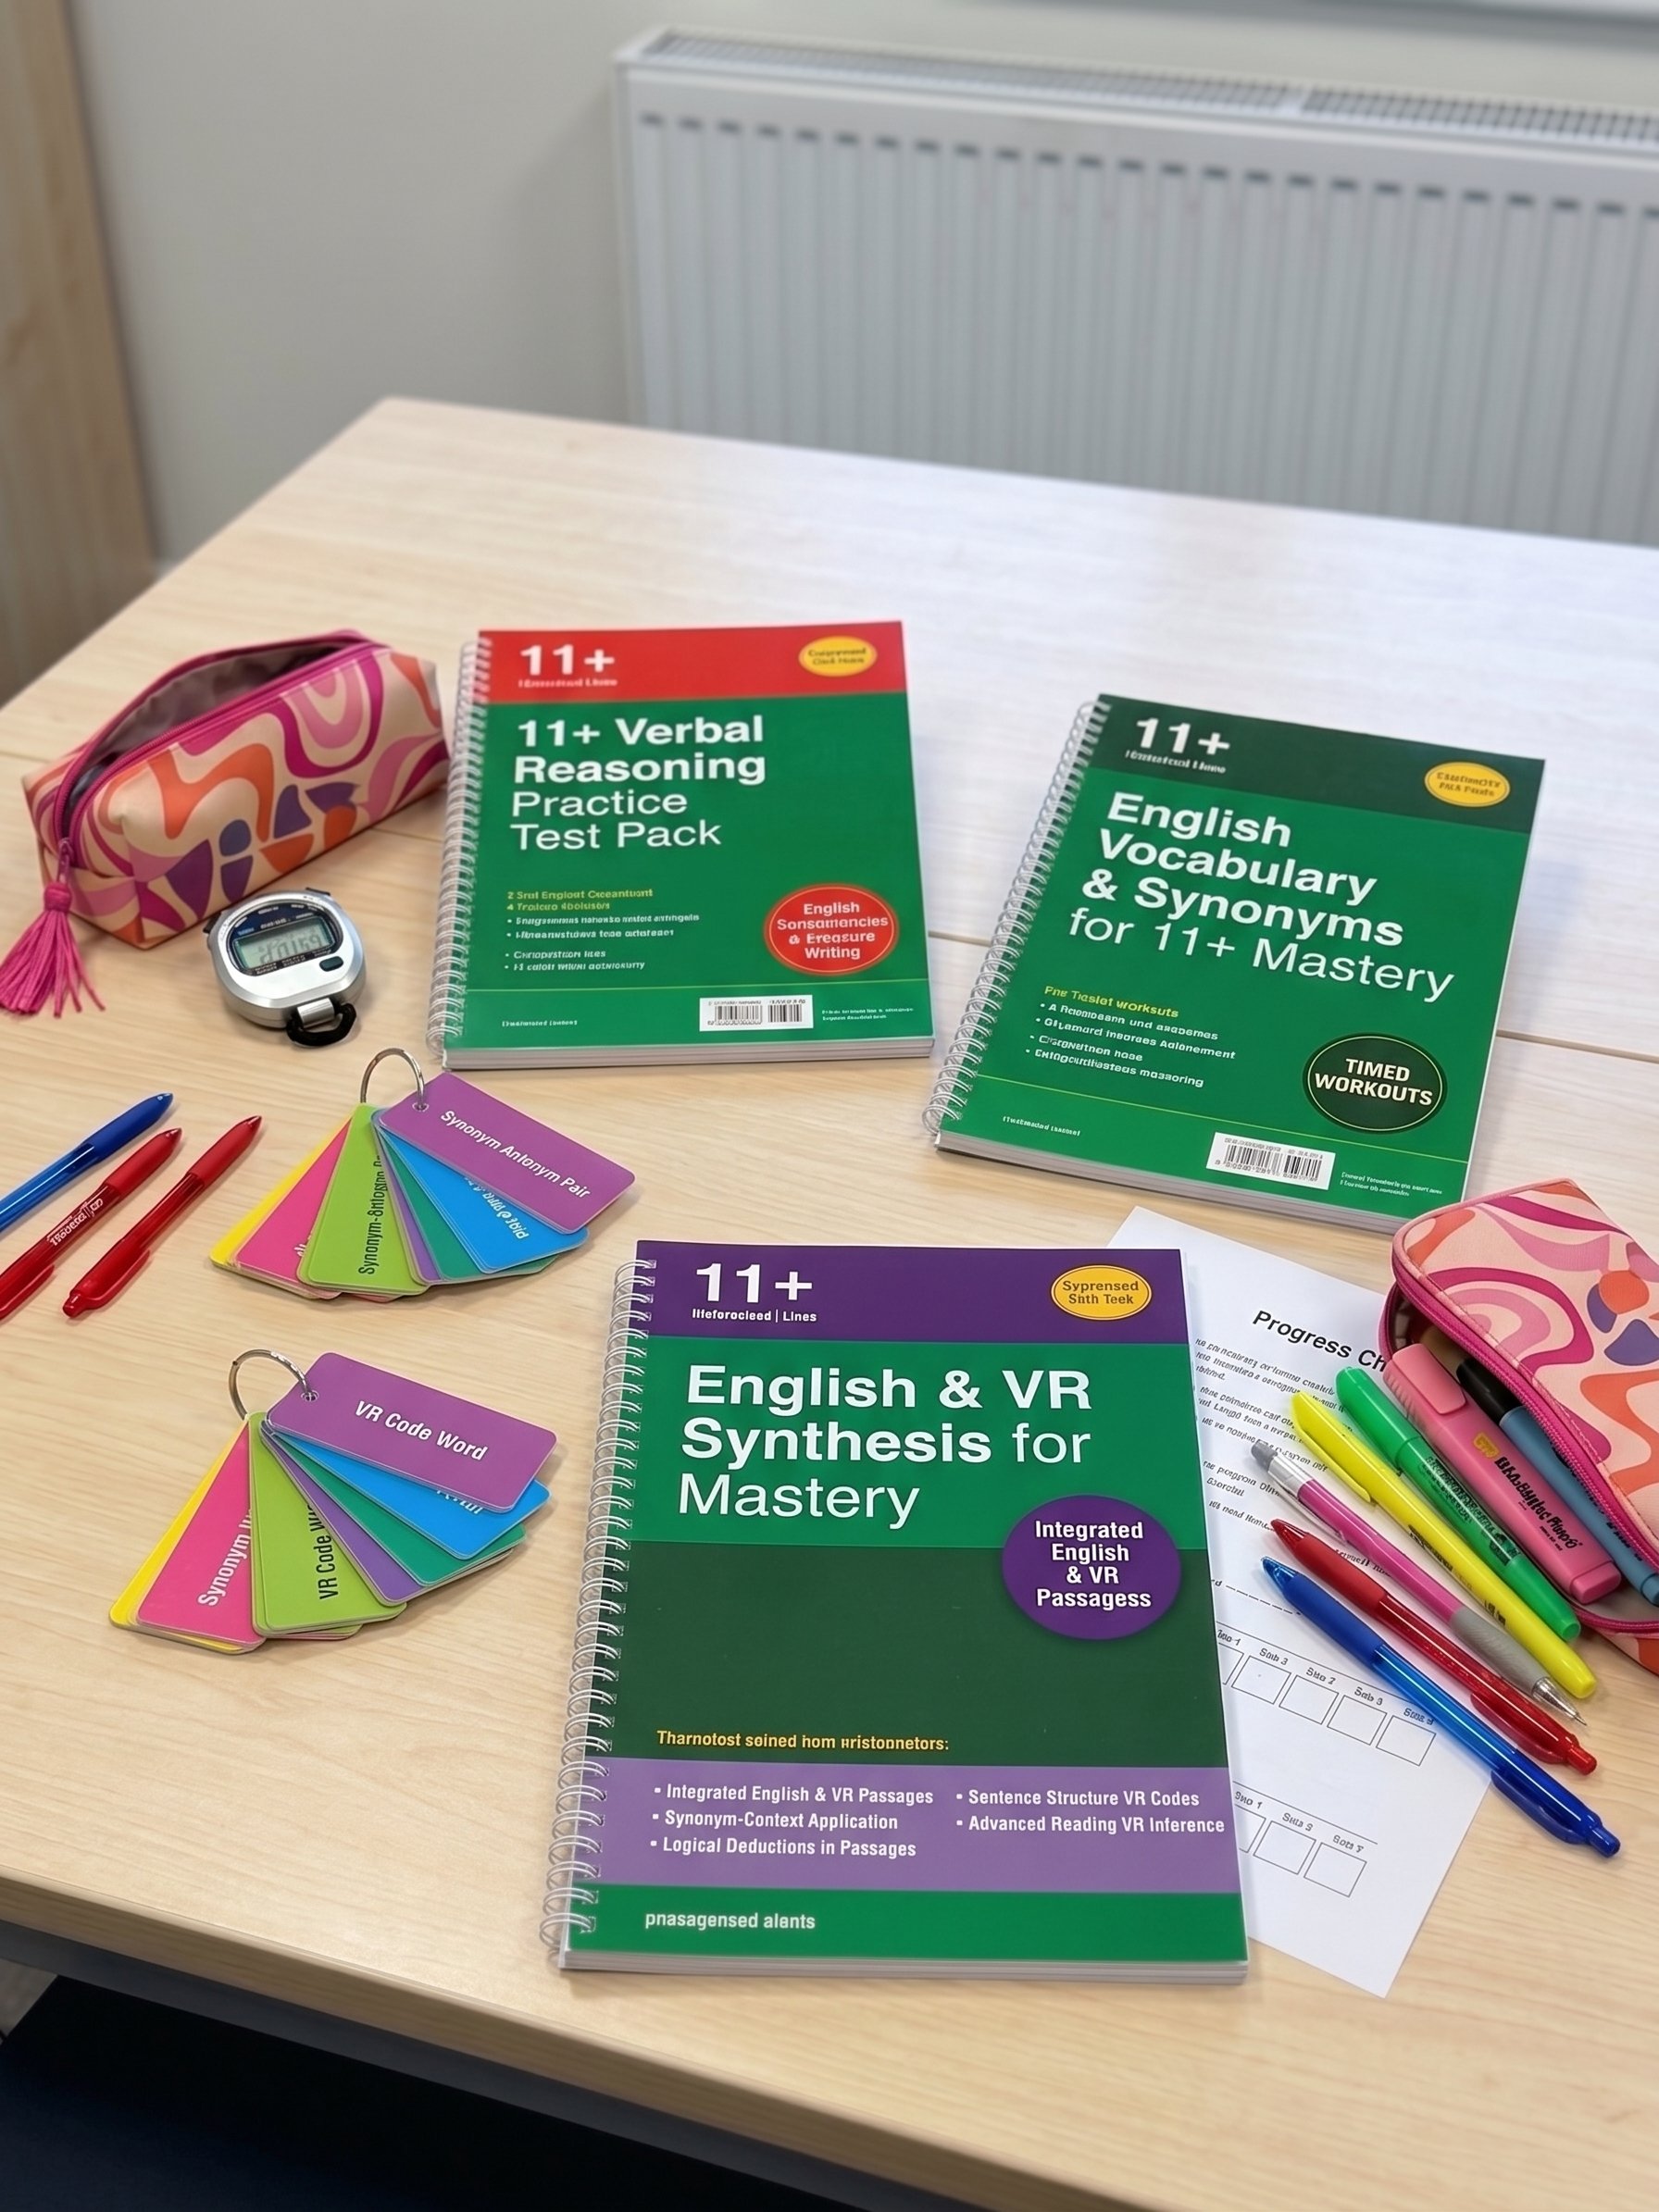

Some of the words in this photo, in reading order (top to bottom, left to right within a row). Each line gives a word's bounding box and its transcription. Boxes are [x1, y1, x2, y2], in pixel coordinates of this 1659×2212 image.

[520, 643, 616, 677] 11+
[518, 719, 601, 748] 11+
[615, 715, 764, 746] Verbal
[1136, 717, 1230, 755] 11+
[514, 752, 767, 786] Reasoning
[511, 789, 688, 817] Practice
[509, 823, 600, 851] Test
[617, 819, 722, 849] Pack
[1107, 791, 1291, 849] English
[1099, 828, 1378, 907] Vocabulary
[804, 901, 860, 917] English
[1081, 868, 1118, 901] &
[1134, 875, 1404, 947] Synonyms
[805, 946, 861, 961] Writing
[1068, 907, 1134, 944] for
[1154, 922, 1236, 959] 11+
[1252, 938, 1455, 1005] Mastery
[1345, 1058, 1411, 1082] TIMED
[1315, 1073, 1433, 1106] WORKOUTS
[440, 1110, 501, 1151] Synonym
[559, 1174, 592, 1200] Pair
[696, 1262, 813, 1303] 11+
[1252, 1310, 1353, 1360] Progress
[686, 1364, 917, 1416] English
[938, 1370, 982, 1410] &
[1002, 1369, 1092, 1410] VR
[355, 1400, 383, 1423] VR
[384, 1412, 433, 1442] Code
[435, 1430, 489, 1462] Word
[681, 1416, 992, 1471] Synthesis
[1012, 1423, 1091, 1464] for
[678, 1473, 920, 1530] Mastery
[1034, 1520, 1144, 1541] Integrated
[313, 1535, 335, 1573] Code
[1051, 1543, 1130, 1564] English
[197, 1534, 251, 1607] Synonym
[1066, 1565, 1082, 1585] &
[1088, 1565, 1119, 1584] VR
[318, 1577, 338, 1599] VR
[1036, 1586, 1153, 1610] Passagess
[667, 1783, 747, 1802] Integrated
[752, 1785, 809, 1804] English
[815, 1786, 827, 1802] &
[831, 1786, 854, 1802] VR
[858, 1787, 934, 1806] Passages
[968, 1789, 1042, 1806] Sentence
[1046, 1790, 1118, 1806] Structure
[1123, 1790, 1146, 1806] VR
[1151, 1791, 1200, 1807] Codes
[665, 1809, 805, 1830] Synonym-Context
[807, 1812, 899, 1832] Application
[968, 1815, 1046, 1832] Advanced
[1051, 1816, 1116, 1835] Reading
[1121, 1817, 1144, 1832] VR
[1150, 1817, 1226, 1833] Inference
[663, 1837, 721, 1857] Logical
[726, 1838, 816, 1855] Deductions
[820, 1839, 835, 1855] in
[840, 1840, 917, 1859] Passages
